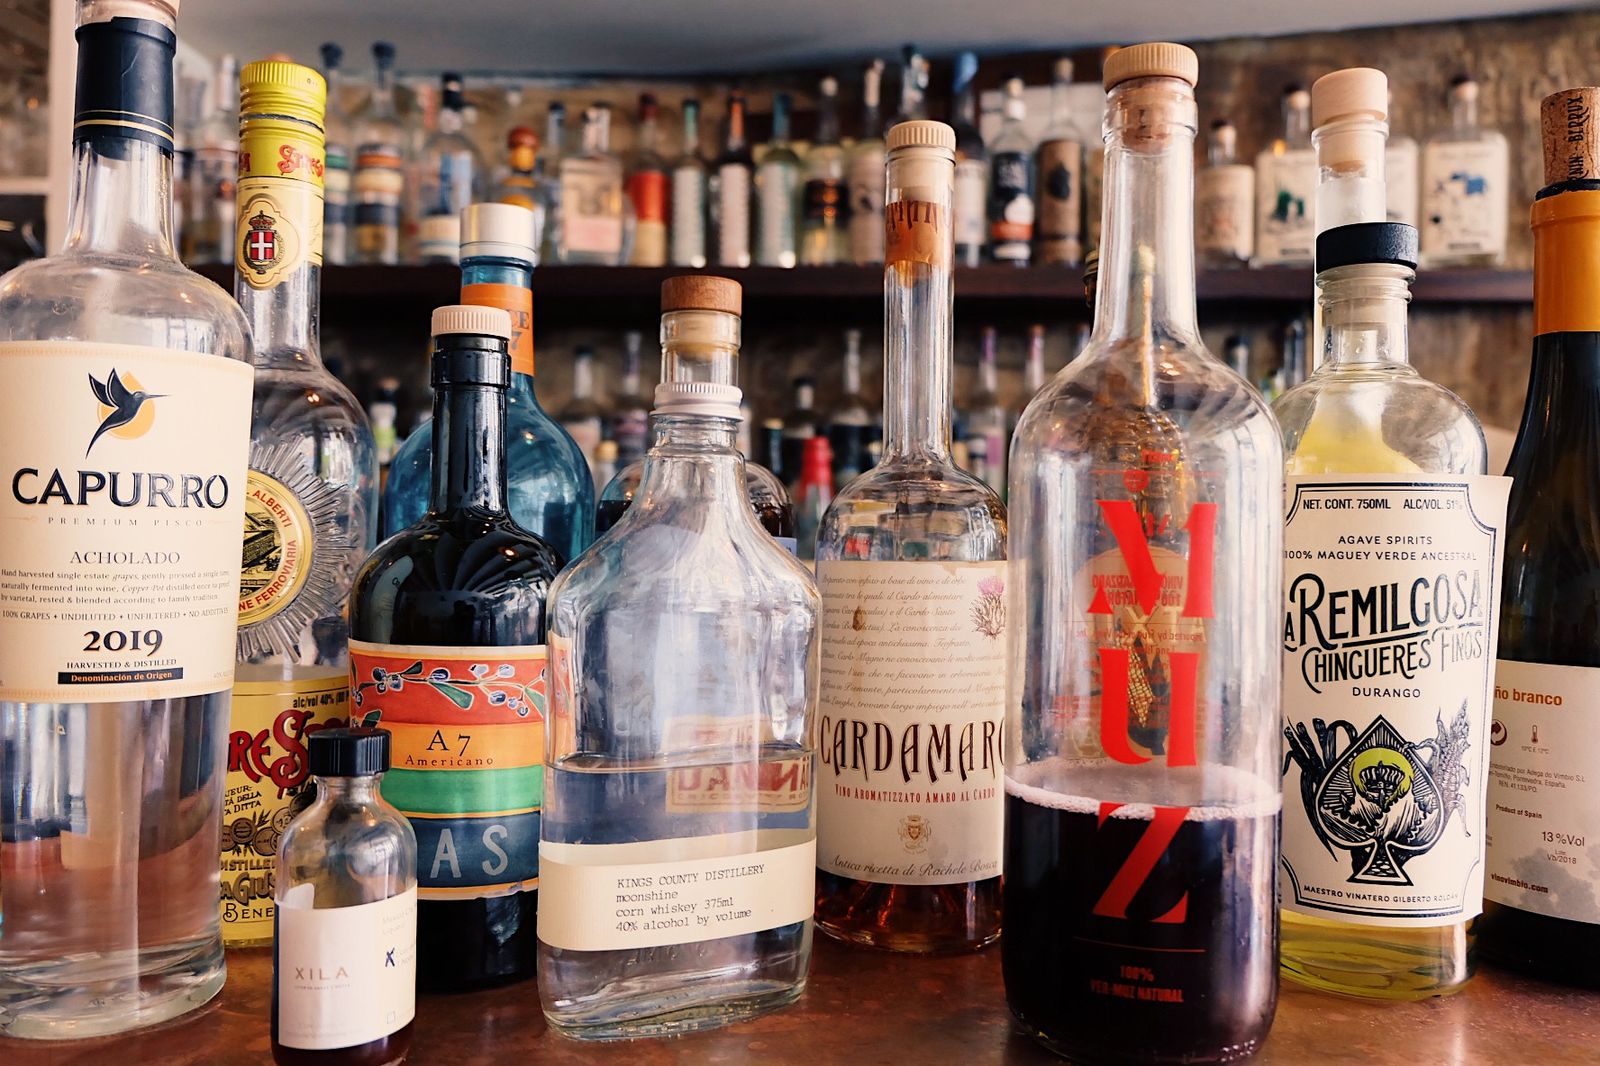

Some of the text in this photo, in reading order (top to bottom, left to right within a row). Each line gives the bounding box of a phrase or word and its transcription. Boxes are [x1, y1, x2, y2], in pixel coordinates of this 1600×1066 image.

[12, 467, 229, 509] CAPURRO
[252, 489, 293, 528] ALBERTI
[1303, 498, 1323, 510] NET.
[1325, 498, 1354, 510] CONT.
[1357, 498, 1391, 510] 750ML
[1403, 498, 1444, 510] ALC/VOL.
[48, 516, 203, 526] PREMIUM PISCO
[1338, 535, 1433, 545] AGAVE SPIRITS
[70, 551, 181, 565] ACHOLADO
[1284, 550, 1476, 561] 100% MAGUEY VERDE ANCESTRAL
[18, 569, 54, 579] harvested
[57, 572, 81, 580] single
[142, 572, 165, 580] gently
[256, 539, 298, 606] FERROVIARIA
[1, 582, 30, 591] naturally
[32, 584, 73, 592] fermented
[76, 596, 111, 604] blended
[114, 596, 155, 604] according
[20, 611, 51, 620] GRAPES
[127, 611, 180, 620] UNFILTERED
[1289, 570, 1483, 651] REMILGOSA
[83, 629, 163, 657] 2019
[66, 658, 177, 669] HARVESTED & DISTILLED
[1302, 626, 1483, 694] CHINGUERES FINOS
[71, 671, 173, 682] Denominación de Origen
[884, 686, 957, 697] particolarmente
[1352, 687, 1421, 698] DURANGO
[1512, 688, 1563, 706] branco
[857, 699, 890, 709] trovano
[890, 700, 914, 712] largo
[426, 729, 471, 757] A 7
[405, 754, 494, 767] Americano
[237, 791, 262, 803] DELLA
[835, 783, 995, 803] VINO AROMATIZZATO AMARO AL CARDO
[234, 800, 262, 813] DITTA
[1496, 804, 1515, 814] Product
[1524, 810, 1542, 819] Spain
[1542, 831, 1554, 842] 13
[829, 854, 861, 871] Antica
[863, 863, 900, 876] ricetta
[902, 862, 915, 876] di
[919, 861, 966, 877] Rachele
[617, 864, 765, 889] KINGS COUNTY DISTILLERY
[1491, 873, 1549, 893] vinovimbio.com
[616, 889, 679, 903] moonshine
[1303, 885, 1431, 903] MAESTRO VINATERO GILBERTO
[616, 896, 734, 918] corn whiskey 375ml
[616, 908, 752, 932] 40% alcohol by volume
[295, 967, 349, 980] XILA
[1138, 987, 1184, 1003] NATURAL
